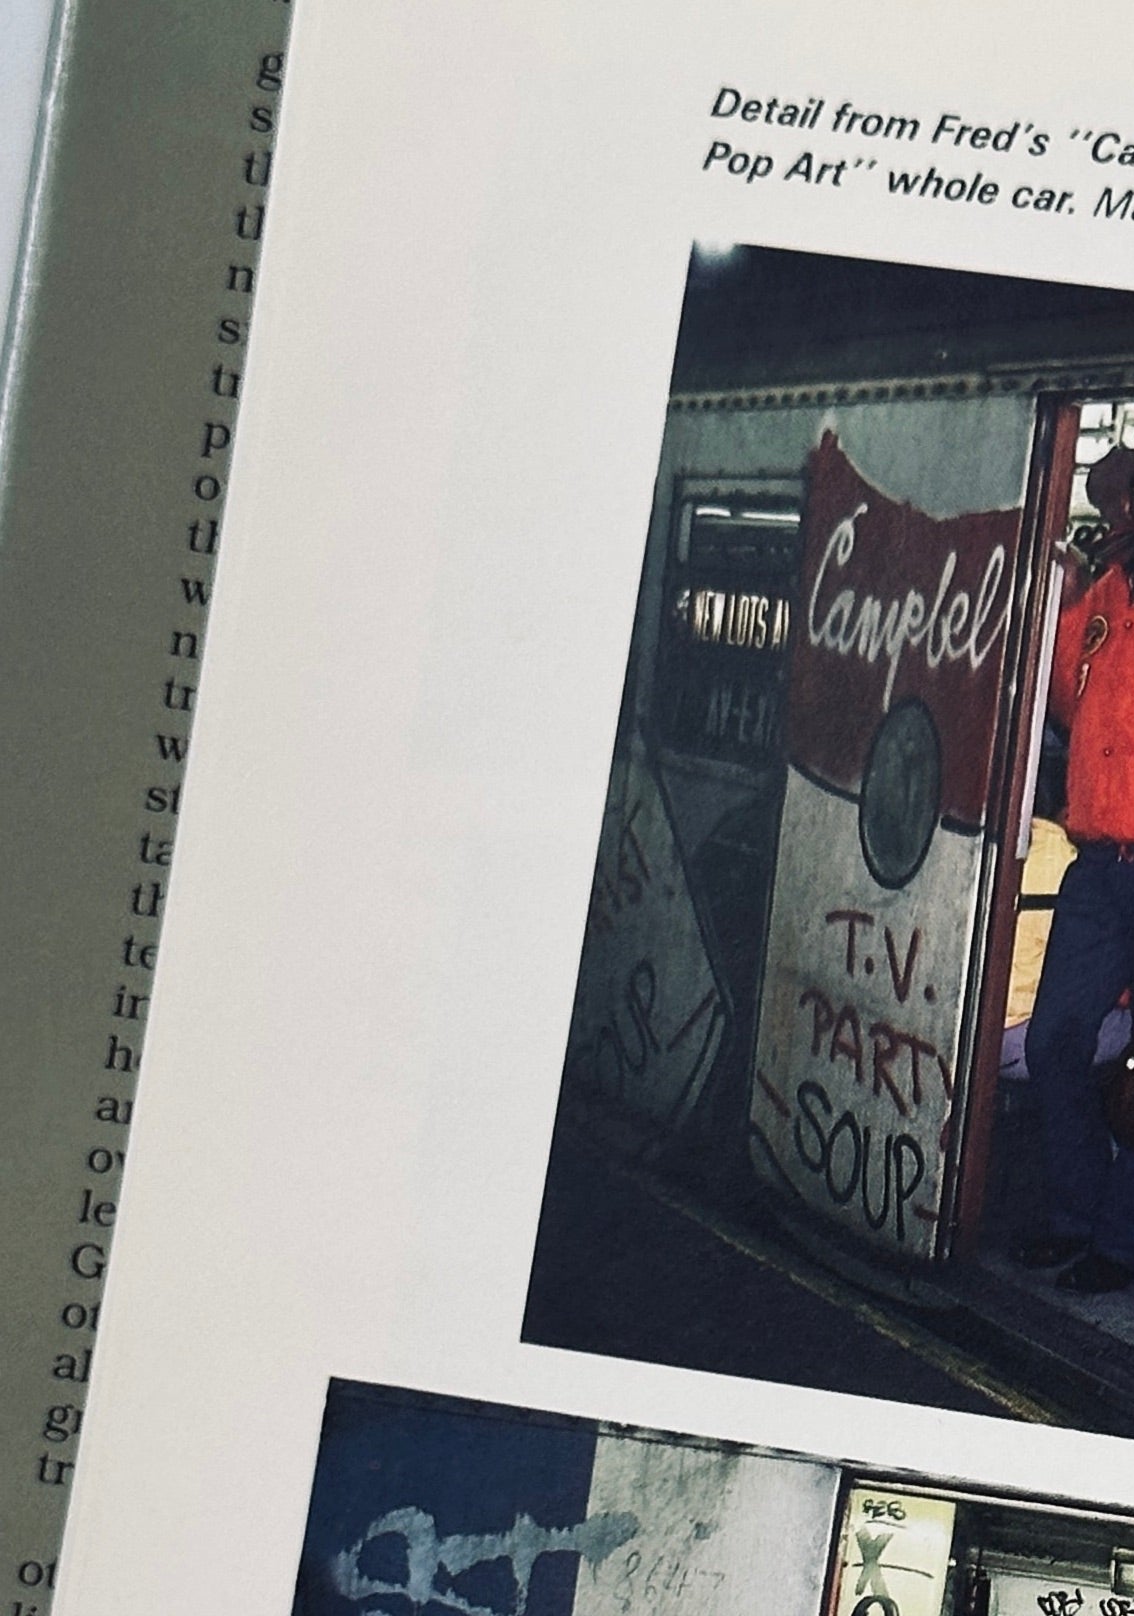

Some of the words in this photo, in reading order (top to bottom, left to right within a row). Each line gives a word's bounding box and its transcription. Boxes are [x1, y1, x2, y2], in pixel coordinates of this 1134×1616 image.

[709, 87, 825, 129] Detail
[832, 102, 920, 141] from
[931, 114, 1050, 156] Fred's
[702, 141, 774, 184] Pop
[887, 167, 1000, 205] whole
[1010, 186, 1075, 214] car.
[727, 594, 770, 650] LOTS
[825, 909, 937, 1004] T.V.
[794, 1080, 925, 1242] SOUP
